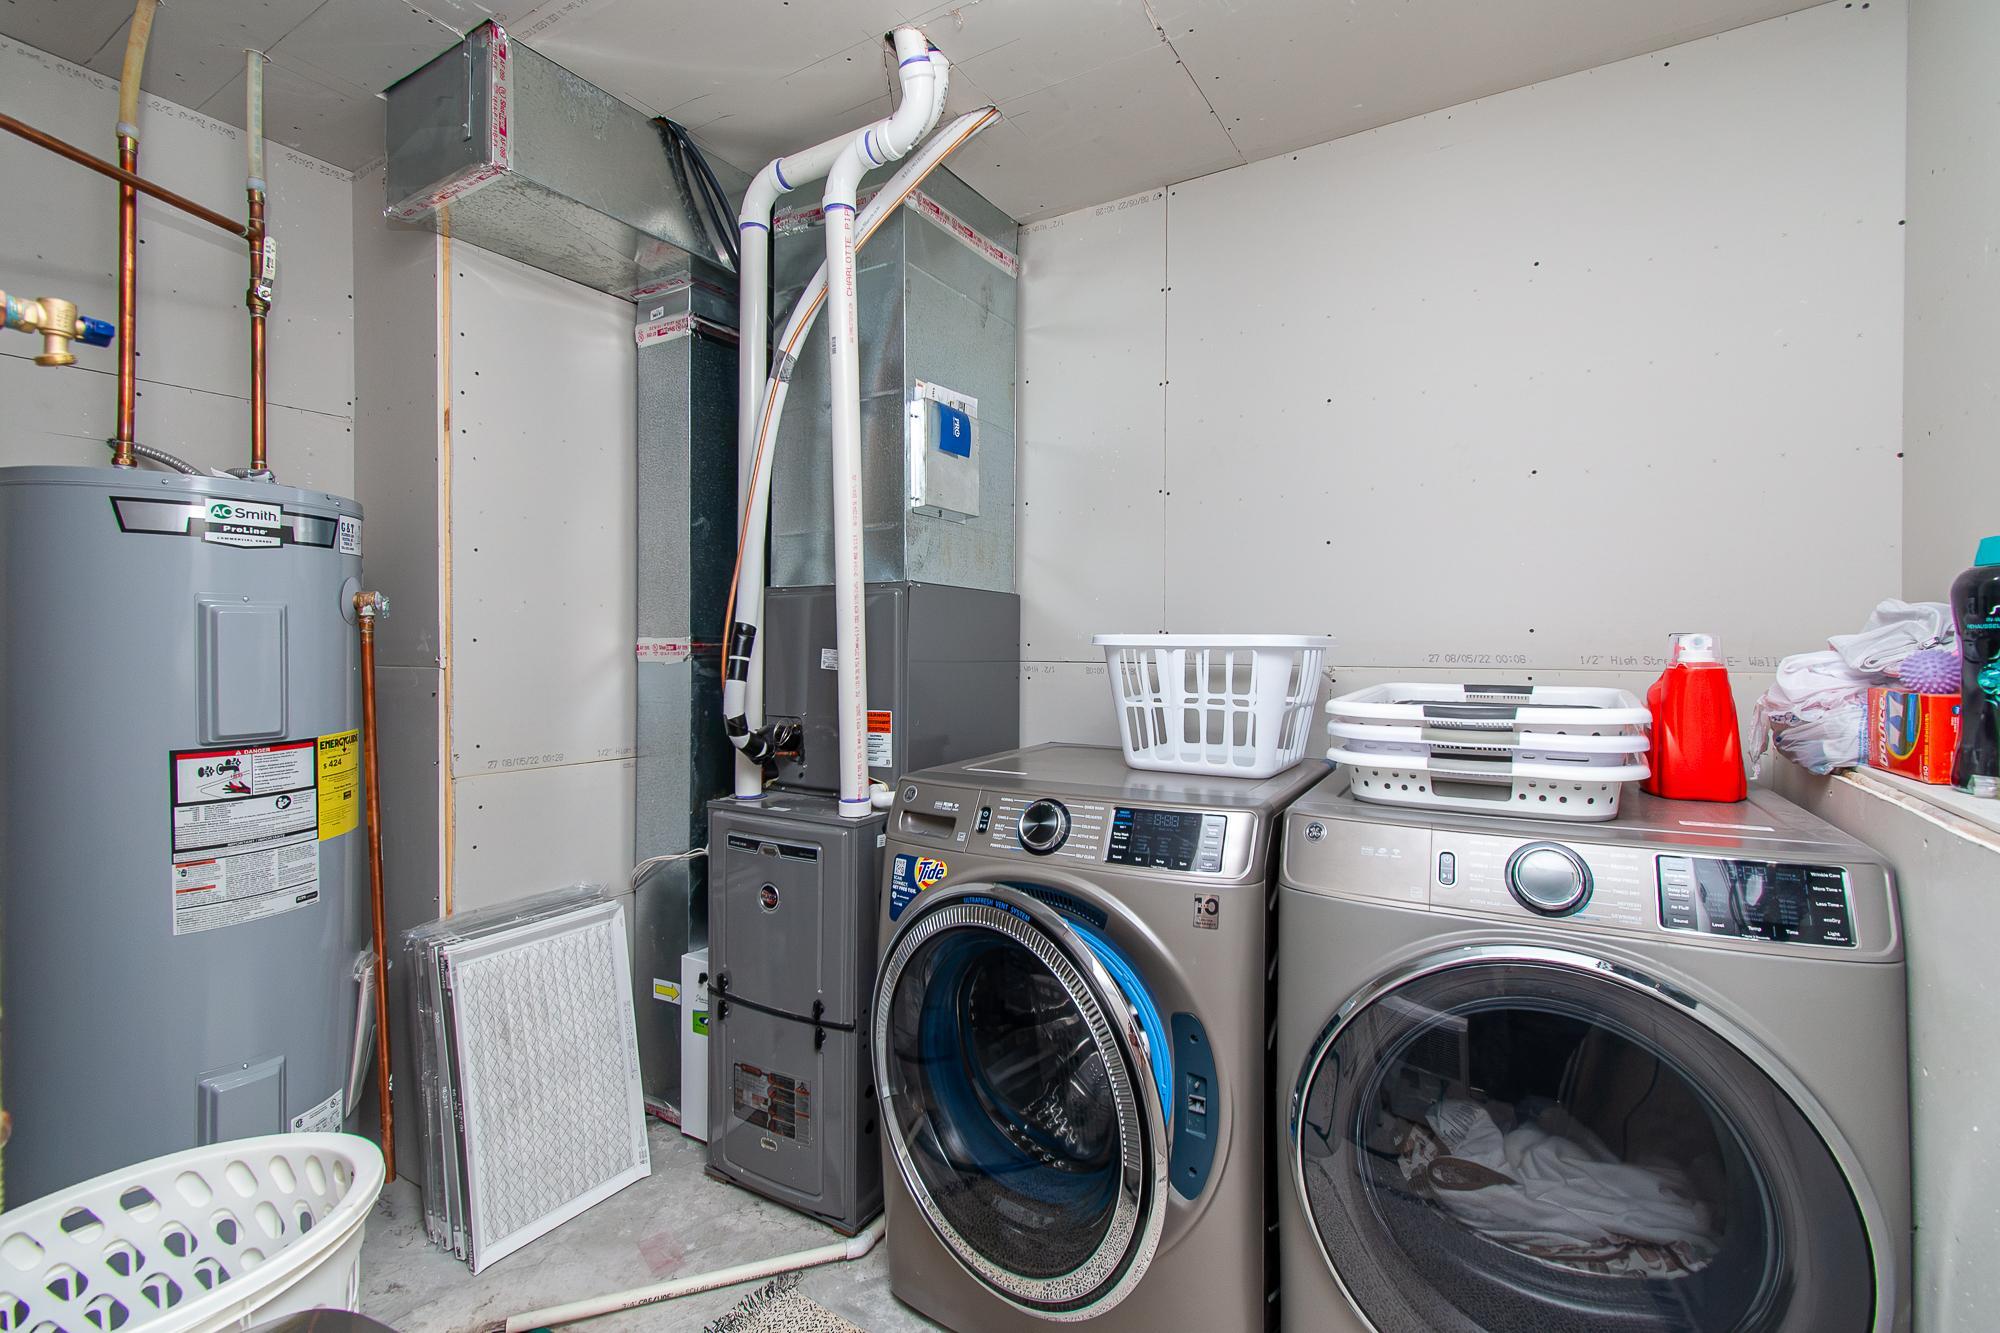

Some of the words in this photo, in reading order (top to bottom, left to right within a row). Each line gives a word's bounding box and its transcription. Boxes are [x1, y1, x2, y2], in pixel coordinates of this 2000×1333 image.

[844, 235, 854, 297] CHARLOTTE
[235, 507, 276, 522] Smith
[223, 525, 266, 535] ProLine
[1444, 654, 1491, 664] 08/05/22
[243, 747, 271, 755] DANGER
[328, 758, 342, 768] 424
[918, 861, 945, 883] Tide
[963, 896, 994, 906] ULTRAFRESH
[995, 900, 1009, 910] VENT
[1010, 906, 1031, 922] SYSTEM
